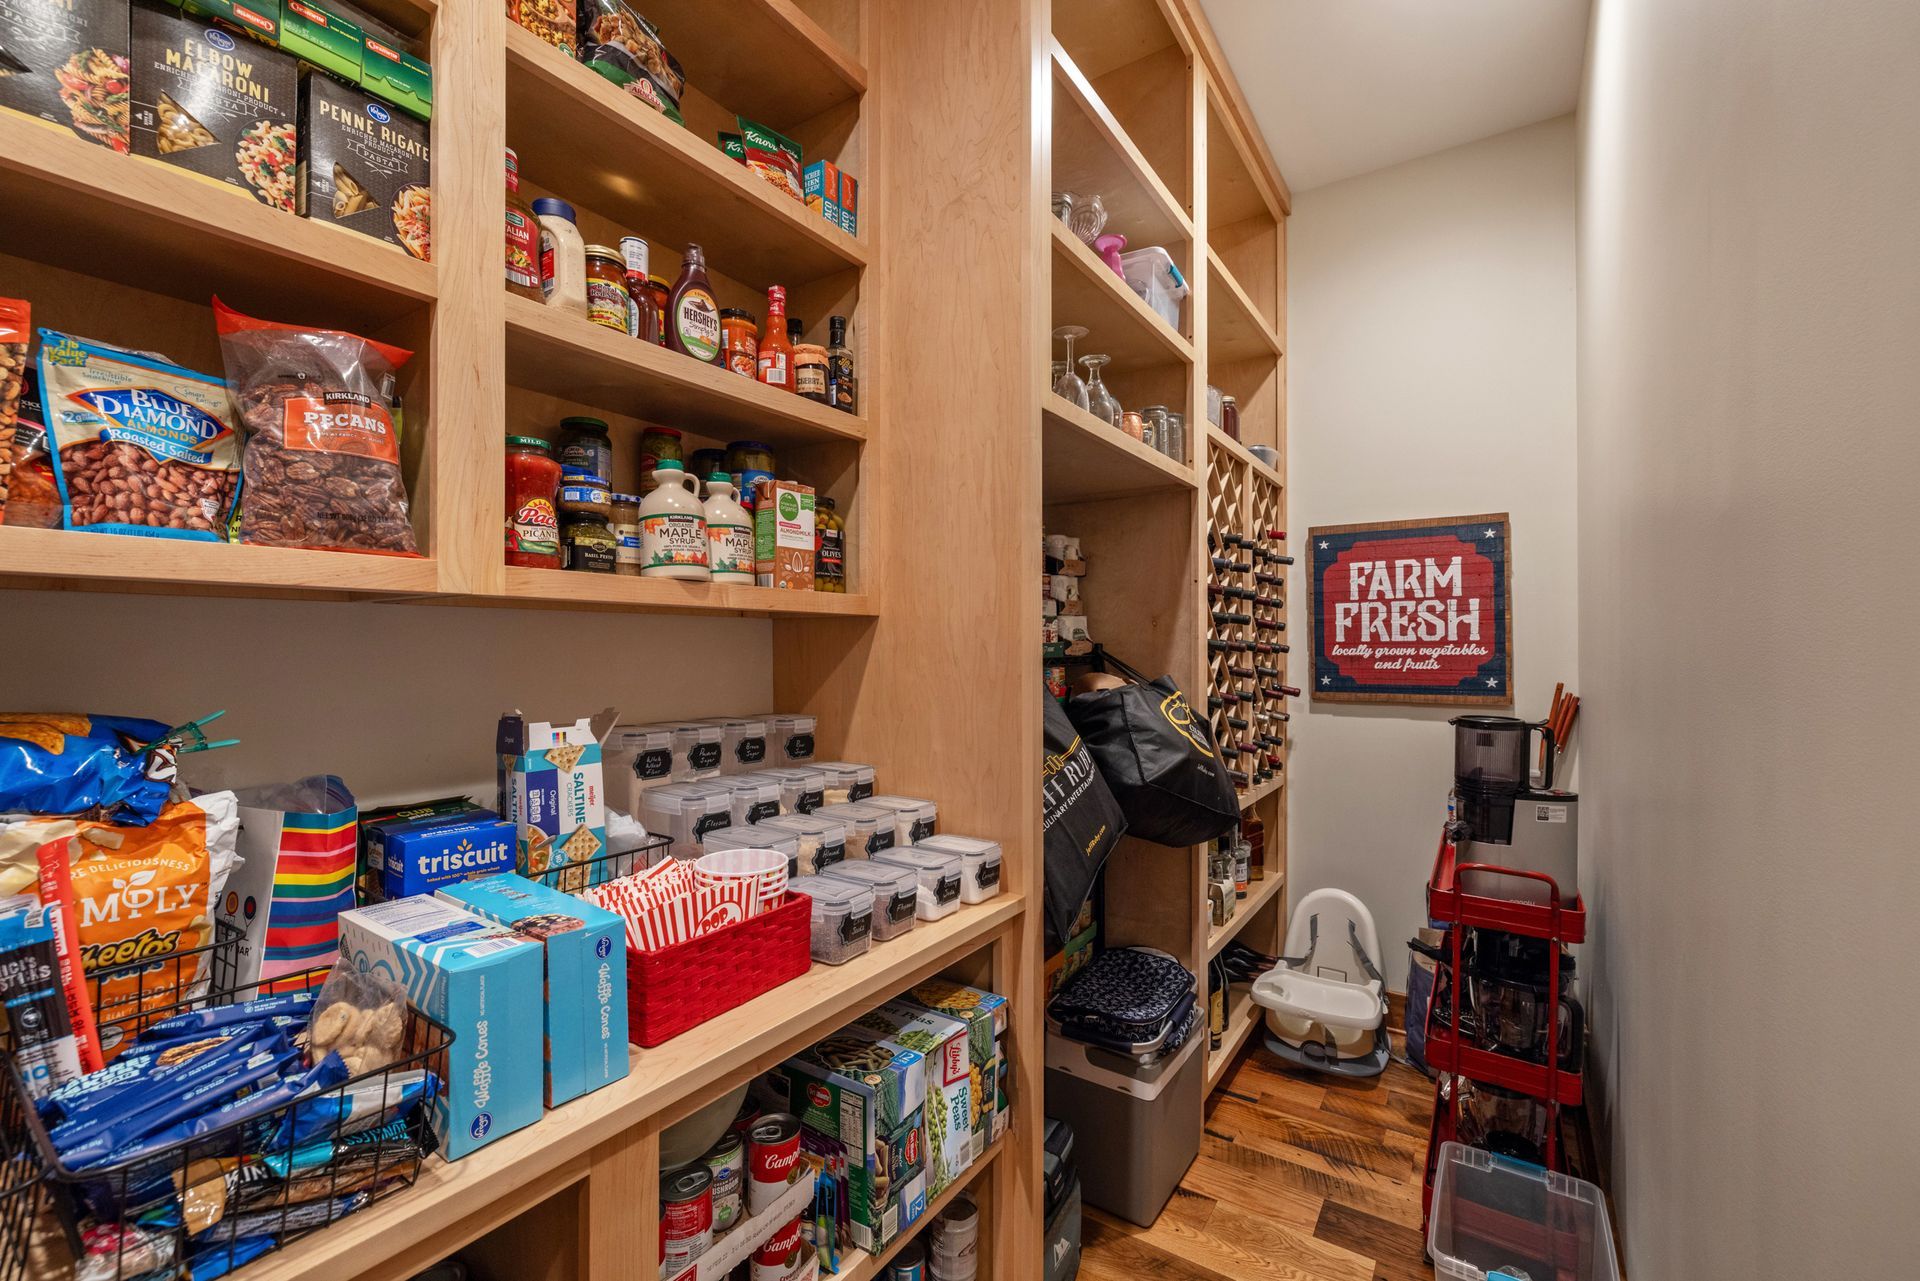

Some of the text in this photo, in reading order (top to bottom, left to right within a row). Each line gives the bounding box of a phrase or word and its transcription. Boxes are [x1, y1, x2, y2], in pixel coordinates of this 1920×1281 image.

[184, 38, 252, 79] ELBOW
[166, 48, 269, 103] MACARONI
[631, 85, 661, 107] ARNOLD
[319, 99, 430, 162] PENNE RIGATE
[744, 130, 779, 152] Knorr
[363, 150, 395, 168] PASTA
[683, 307, 718, 332] HERSHEY'S
[49, 346, 87, 360] Value
[50, 355, 87, 367] Pack
[130, 388, 194, 420] BLUE
[325, 392, 371, 404] KIRKLAND
[93, 392, 218, 441] DIAMOND
[303, 411, 386, 435] PECANS
[126, 418, 199, 446] ALMONDS
[519, 437, 542, 446] MILD
[110, 428, 205, 465] Roasted Salted
[522, 530, 559, 541] PICANTE
[659, 528, 702, 540] MAPLE
[669, 537, 696, 545] SYRUP
[821, 550, 842, 559] OLIVES
[1349, 556, 1463, 601] FARM
[1335, 598, 1481, 643] FRESH
[1332, 643, 1489, 660] locally grown vegetables
[1374, 658, 1441, 673] and fruits
[549, 789, 557, 817] Original
[567, 782, 575, 817] CRACKERS
[574, 772, 586, 825] SALTINE
[89, 857, 191, 873] DELICIOUSNESS
[417, 841, 509, 875] triscuit
[701, 906, 728, 934] POP
[597, 962, 612, 1040] Waffle Cones
[901, 1012, 934, 1026] Peas
[473, 1020, 492, 1109] Waffle Cones
[898, 1051, 914, 1062] 12
[950, 1042, 961, 1077] Libby's
[950, 1094, 961, 1132] Peas
[958, 1086, 970, 1132] Sweet
[473, 1113, 492, 1139] Kroger
[915, 1193, 924, 1215] 12
